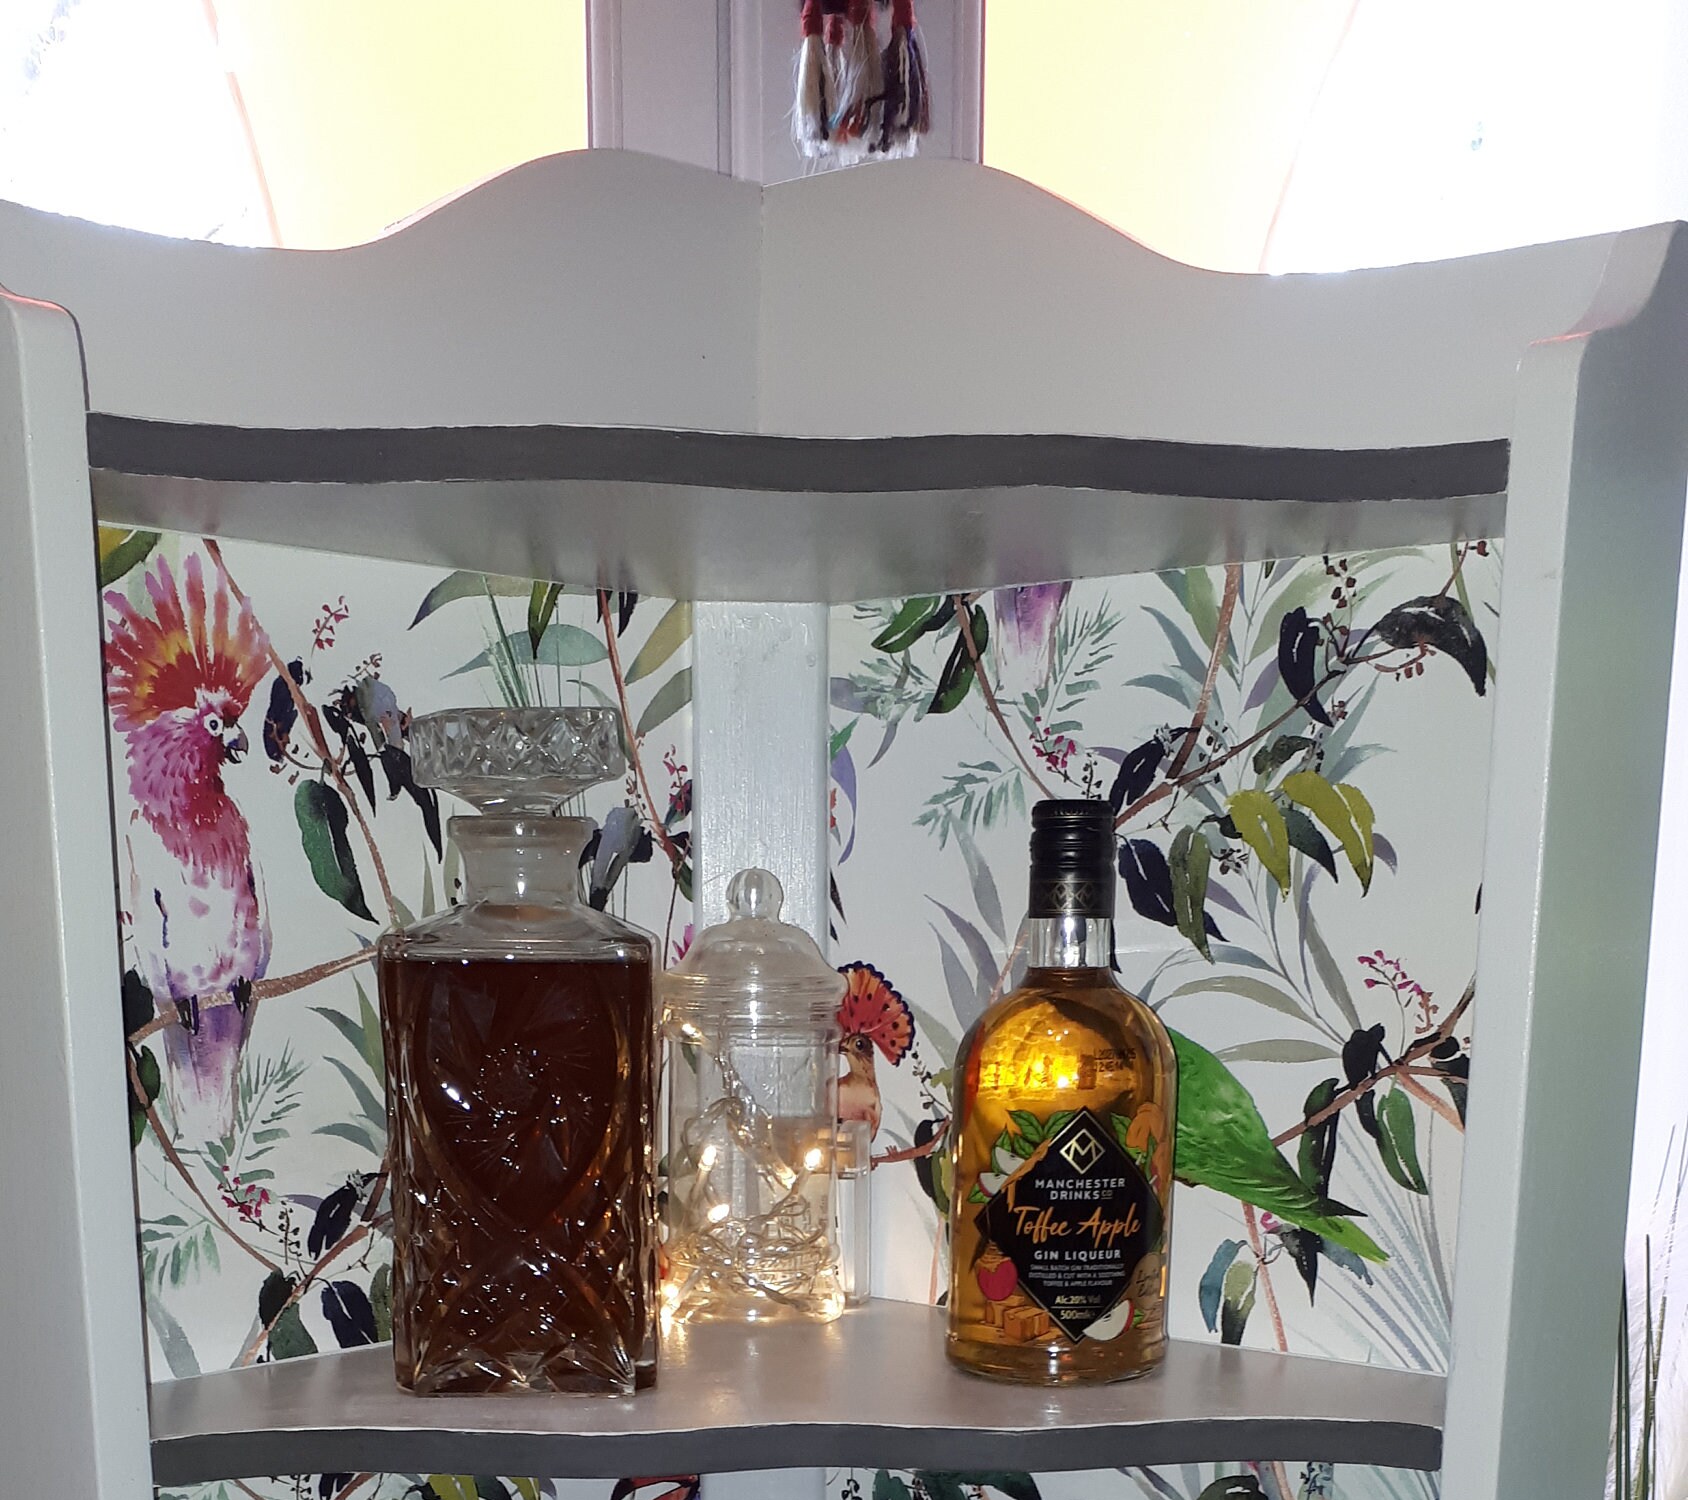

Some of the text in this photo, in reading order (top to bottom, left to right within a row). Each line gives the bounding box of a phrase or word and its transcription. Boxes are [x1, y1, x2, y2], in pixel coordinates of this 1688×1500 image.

[1034, 1178, 1126, 1189] MANCHESTER
[1049, 1190, 1100, 1200] DRINKS
[1013, 1202, 1141, 1249] Toffee Apple
[1034, 1249, 1121, 1262] GIN LIQUEUR
